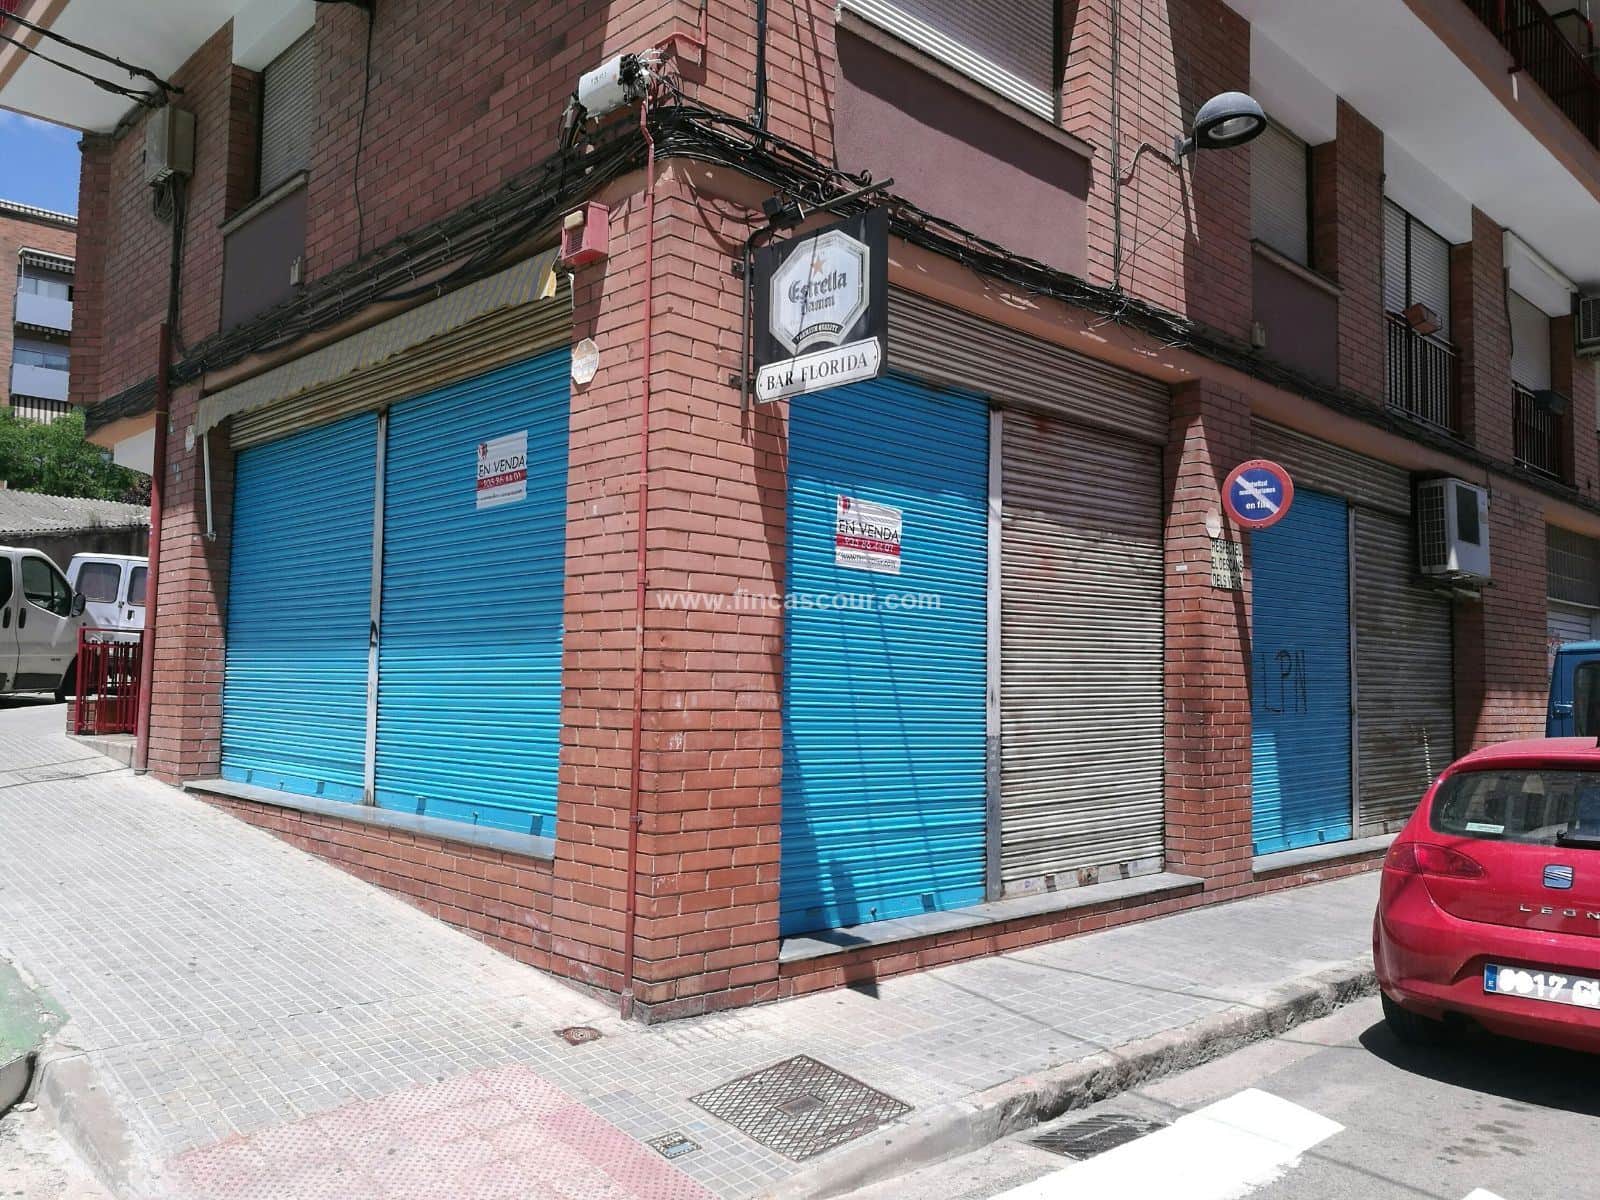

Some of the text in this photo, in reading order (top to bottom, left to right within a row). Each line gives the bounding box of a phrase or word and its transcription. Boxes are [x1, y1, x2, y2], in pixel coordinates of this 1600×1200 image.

[788, 269, 847, 304] Estrella
[766, 351, 868, 391] BAR FLORIDA
[479, 455, 525, 478] EN VENDA
[1245, 502, 1256, 510] en
[838, 519, 899, 543] EN VENDA
[1519, 904, 1600, 919] LEON
